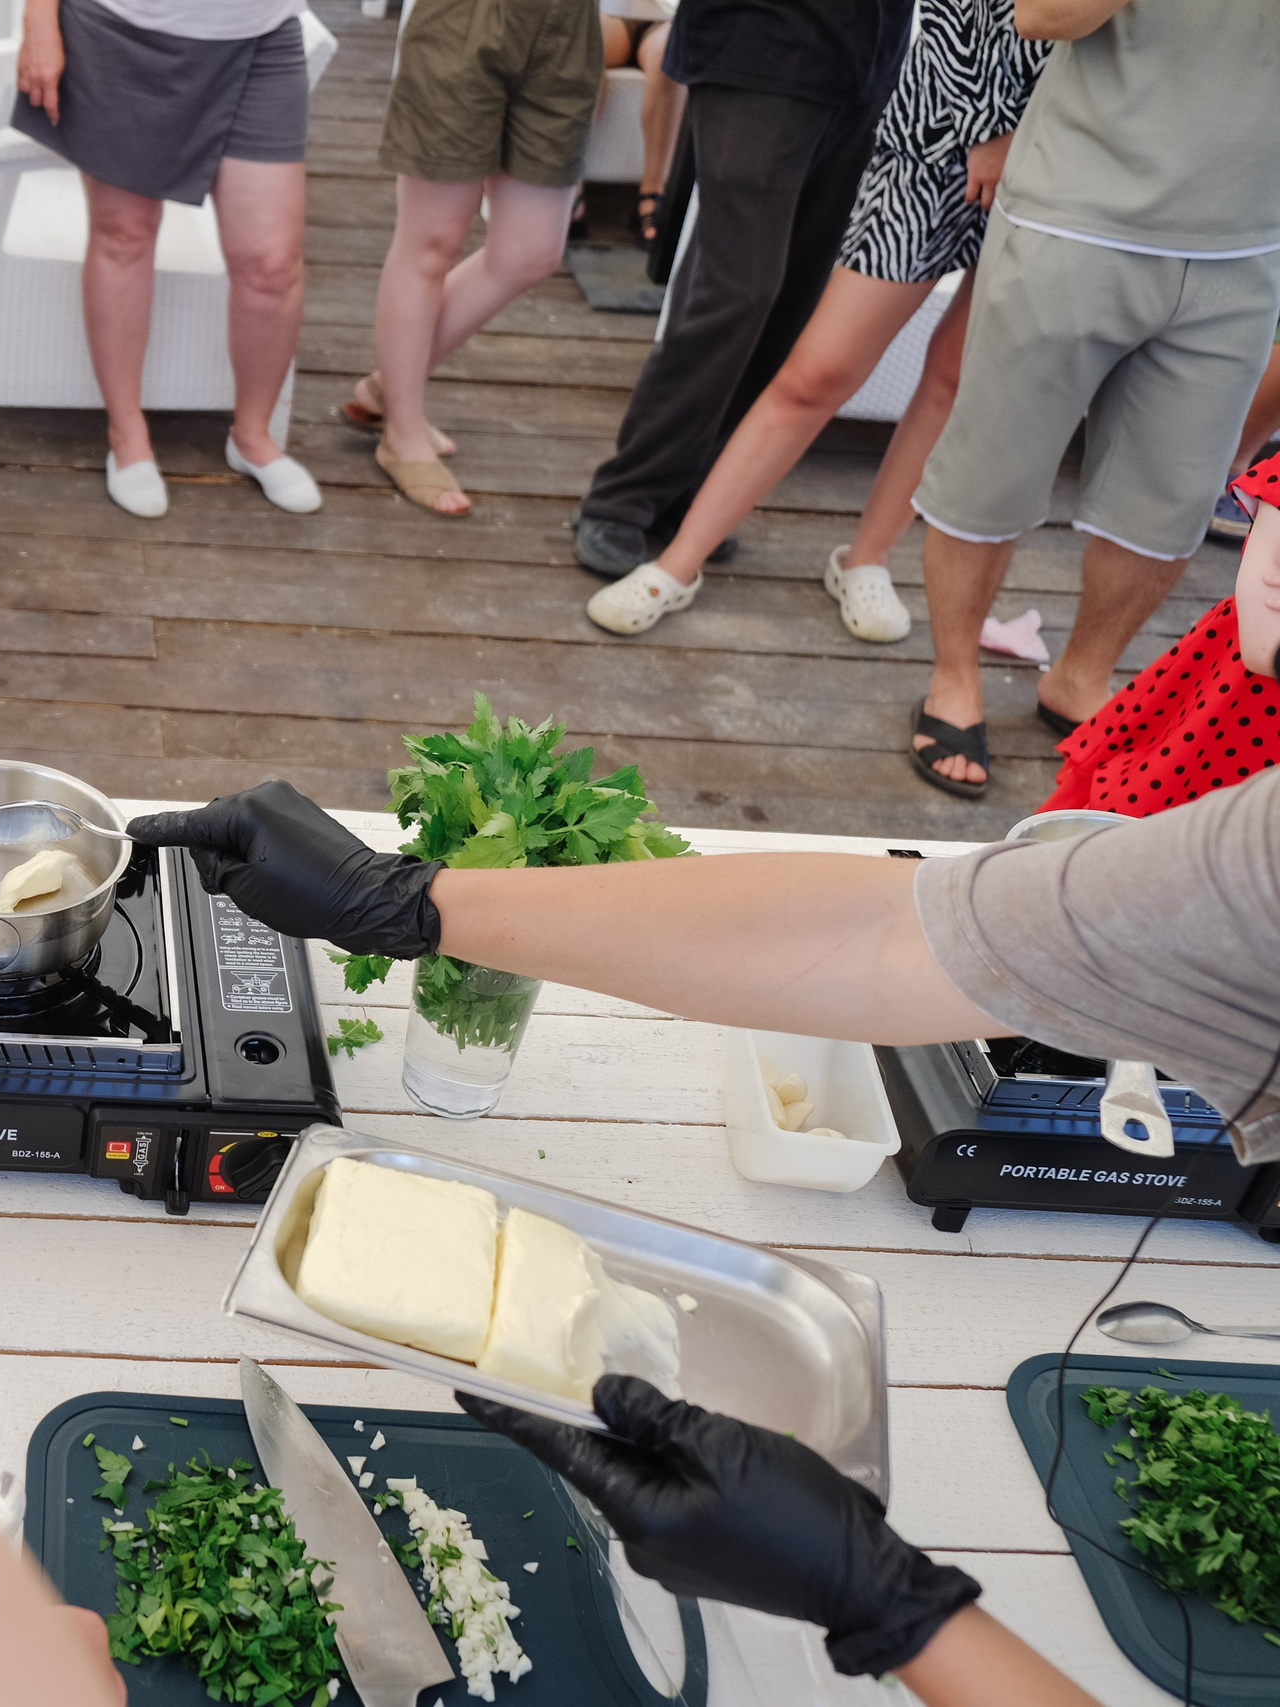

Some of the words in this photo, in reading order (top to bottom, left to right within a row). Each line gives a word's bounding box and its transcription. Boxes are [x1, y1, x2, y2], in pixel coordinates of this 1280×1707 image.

[11, 1150, 60, 1159] BDZ-155-A
[137, 1142, 147, 1160] GAS
[956, 1144, 977, 1157] CE
[999, 1164, 1092, 1183] PORTABLE
[1094, 1169, 1130, 1184] GAS
[1131, 1172, 1188, 1188] STOVE
